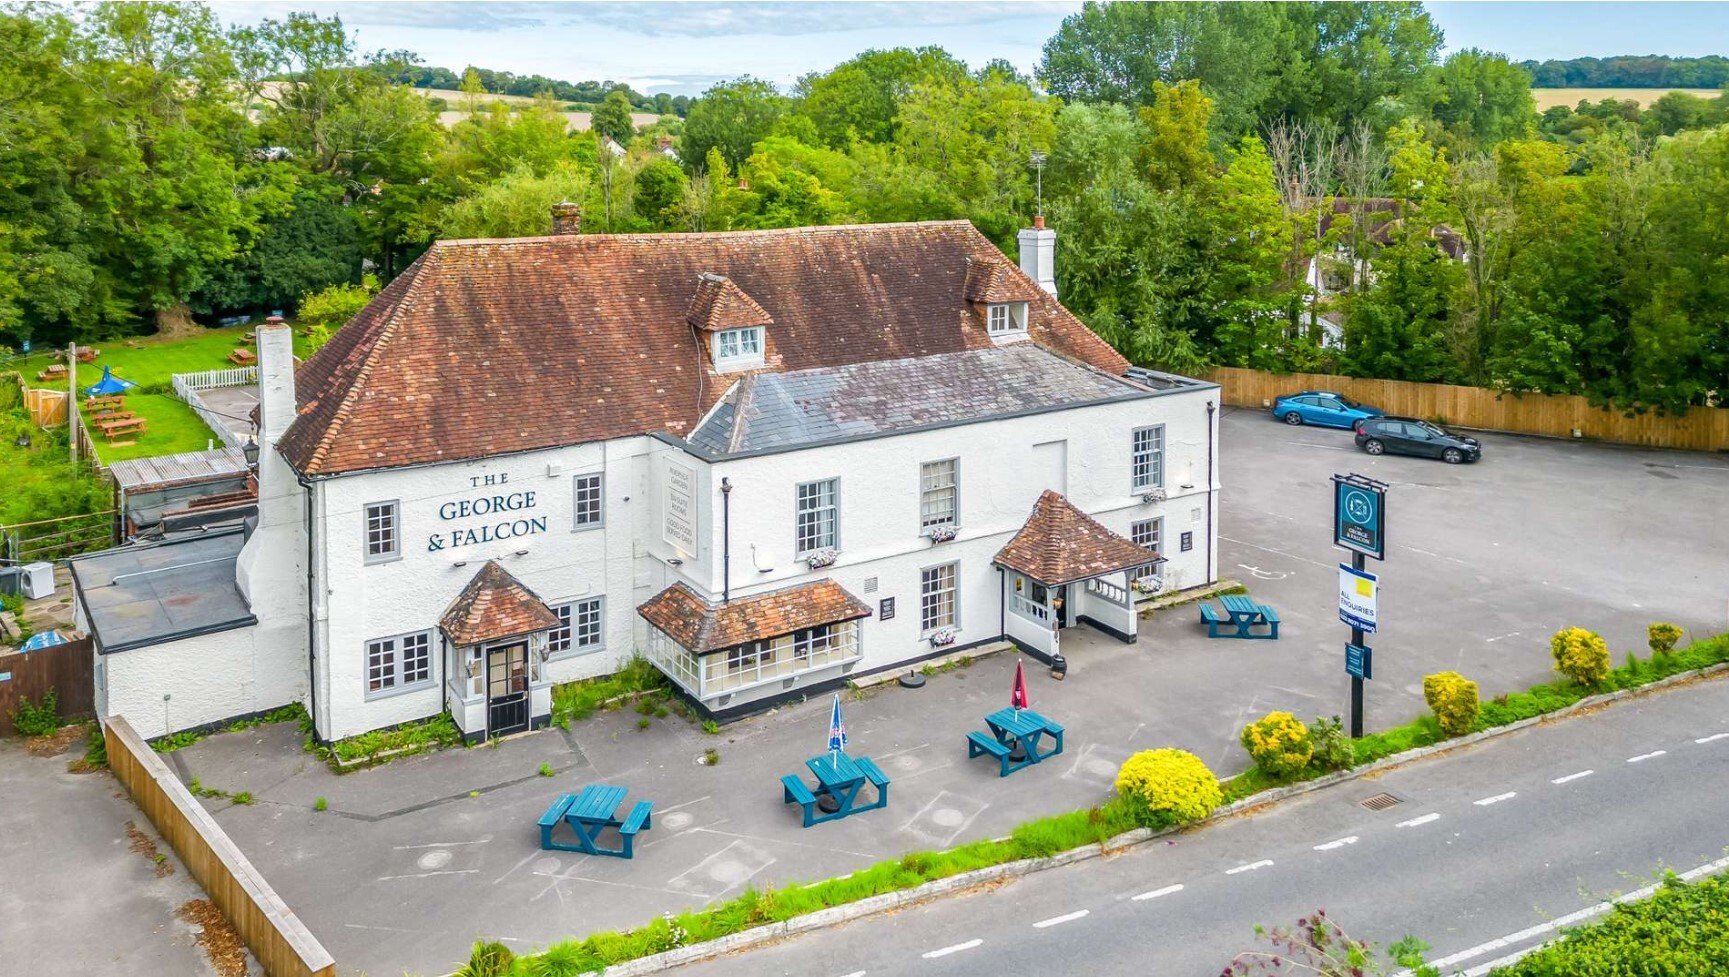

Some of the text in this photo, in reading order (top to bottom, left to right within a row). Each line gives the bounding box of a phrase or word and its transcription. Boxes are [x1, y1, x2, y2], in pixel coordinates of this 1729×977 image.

[470, 473, 508, 487] THE
[440, 491, 536, 520] GEORGE
[428, 516, 547, 552] & FALCON
[1341, 590, 1350, 600] ALL
[1341, 597, 1374, 616] ENQUIRIES
